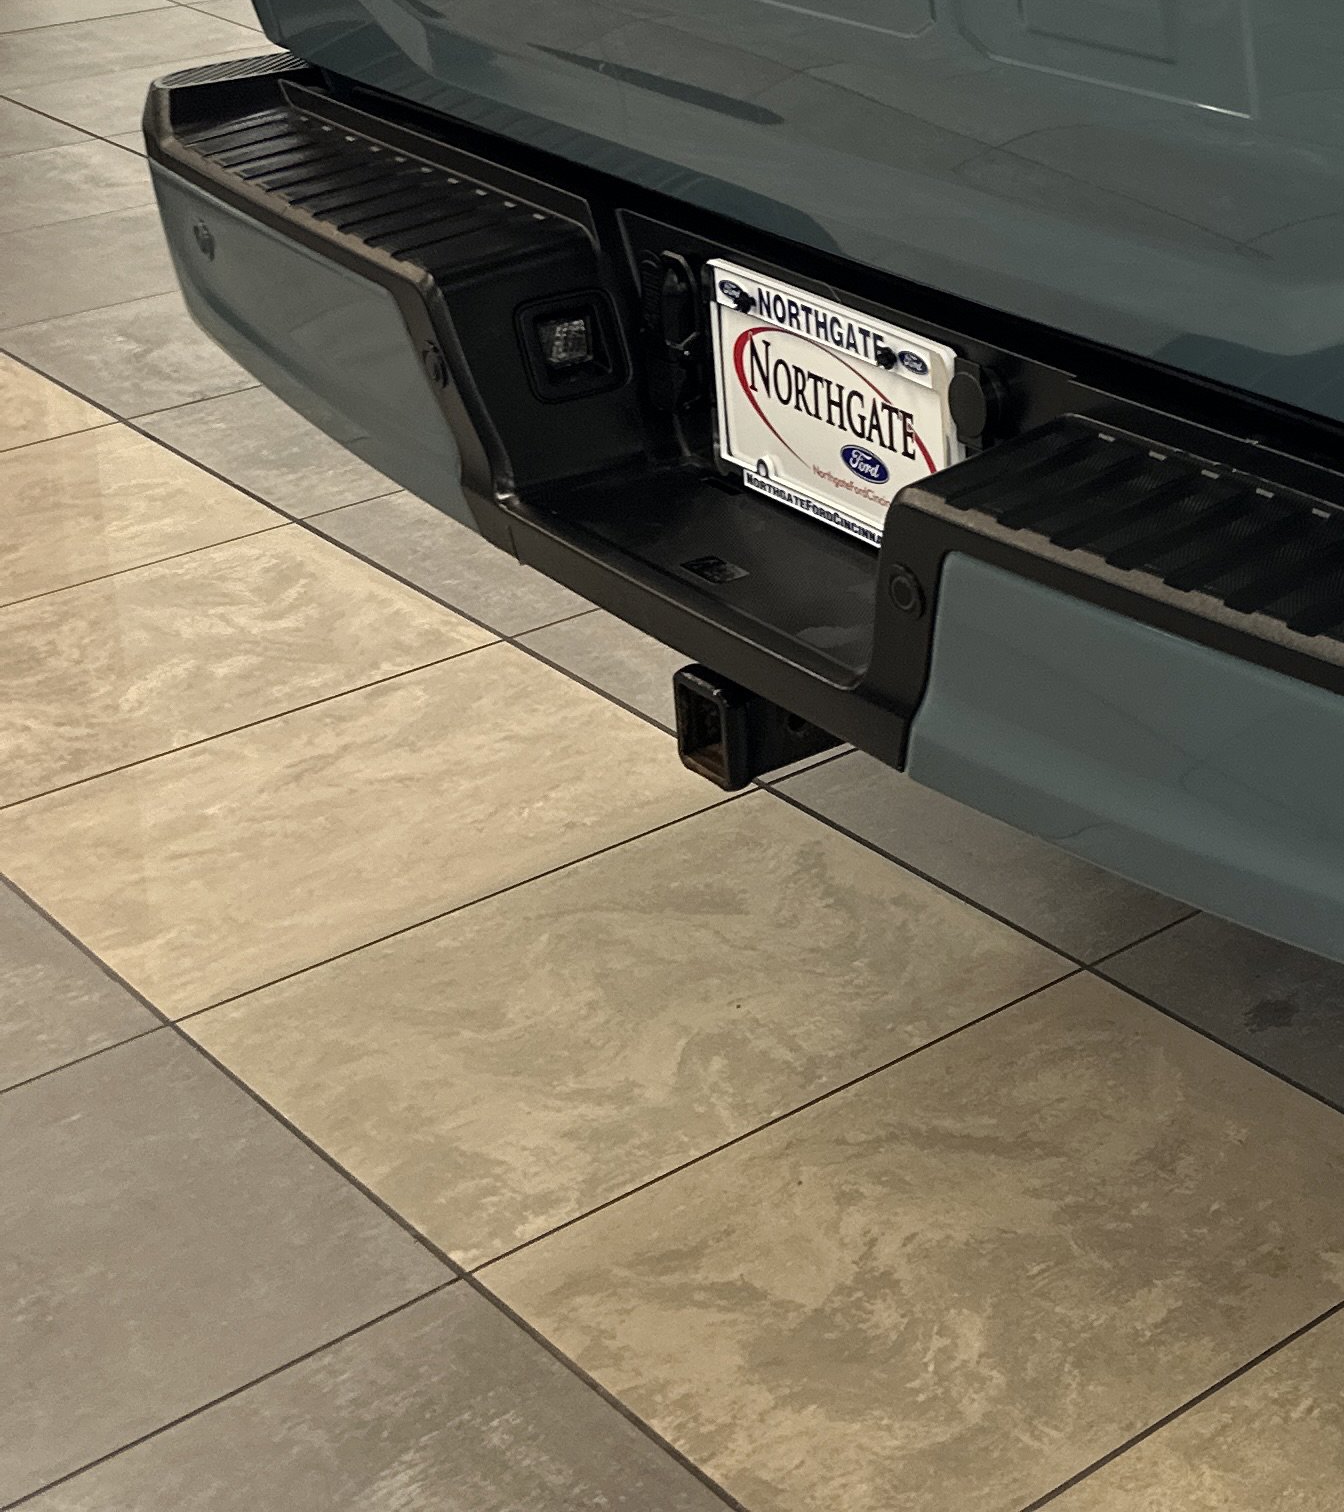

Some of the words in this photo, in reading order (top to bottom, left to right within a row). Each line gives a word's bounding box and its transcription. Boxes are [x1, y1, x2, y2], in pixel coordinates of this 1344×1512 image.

[757, 287, 886, 359] NORTHGATE
[749, 335, 917, 461] NORTHGATE
[848, 449, 881, 479] Ford
